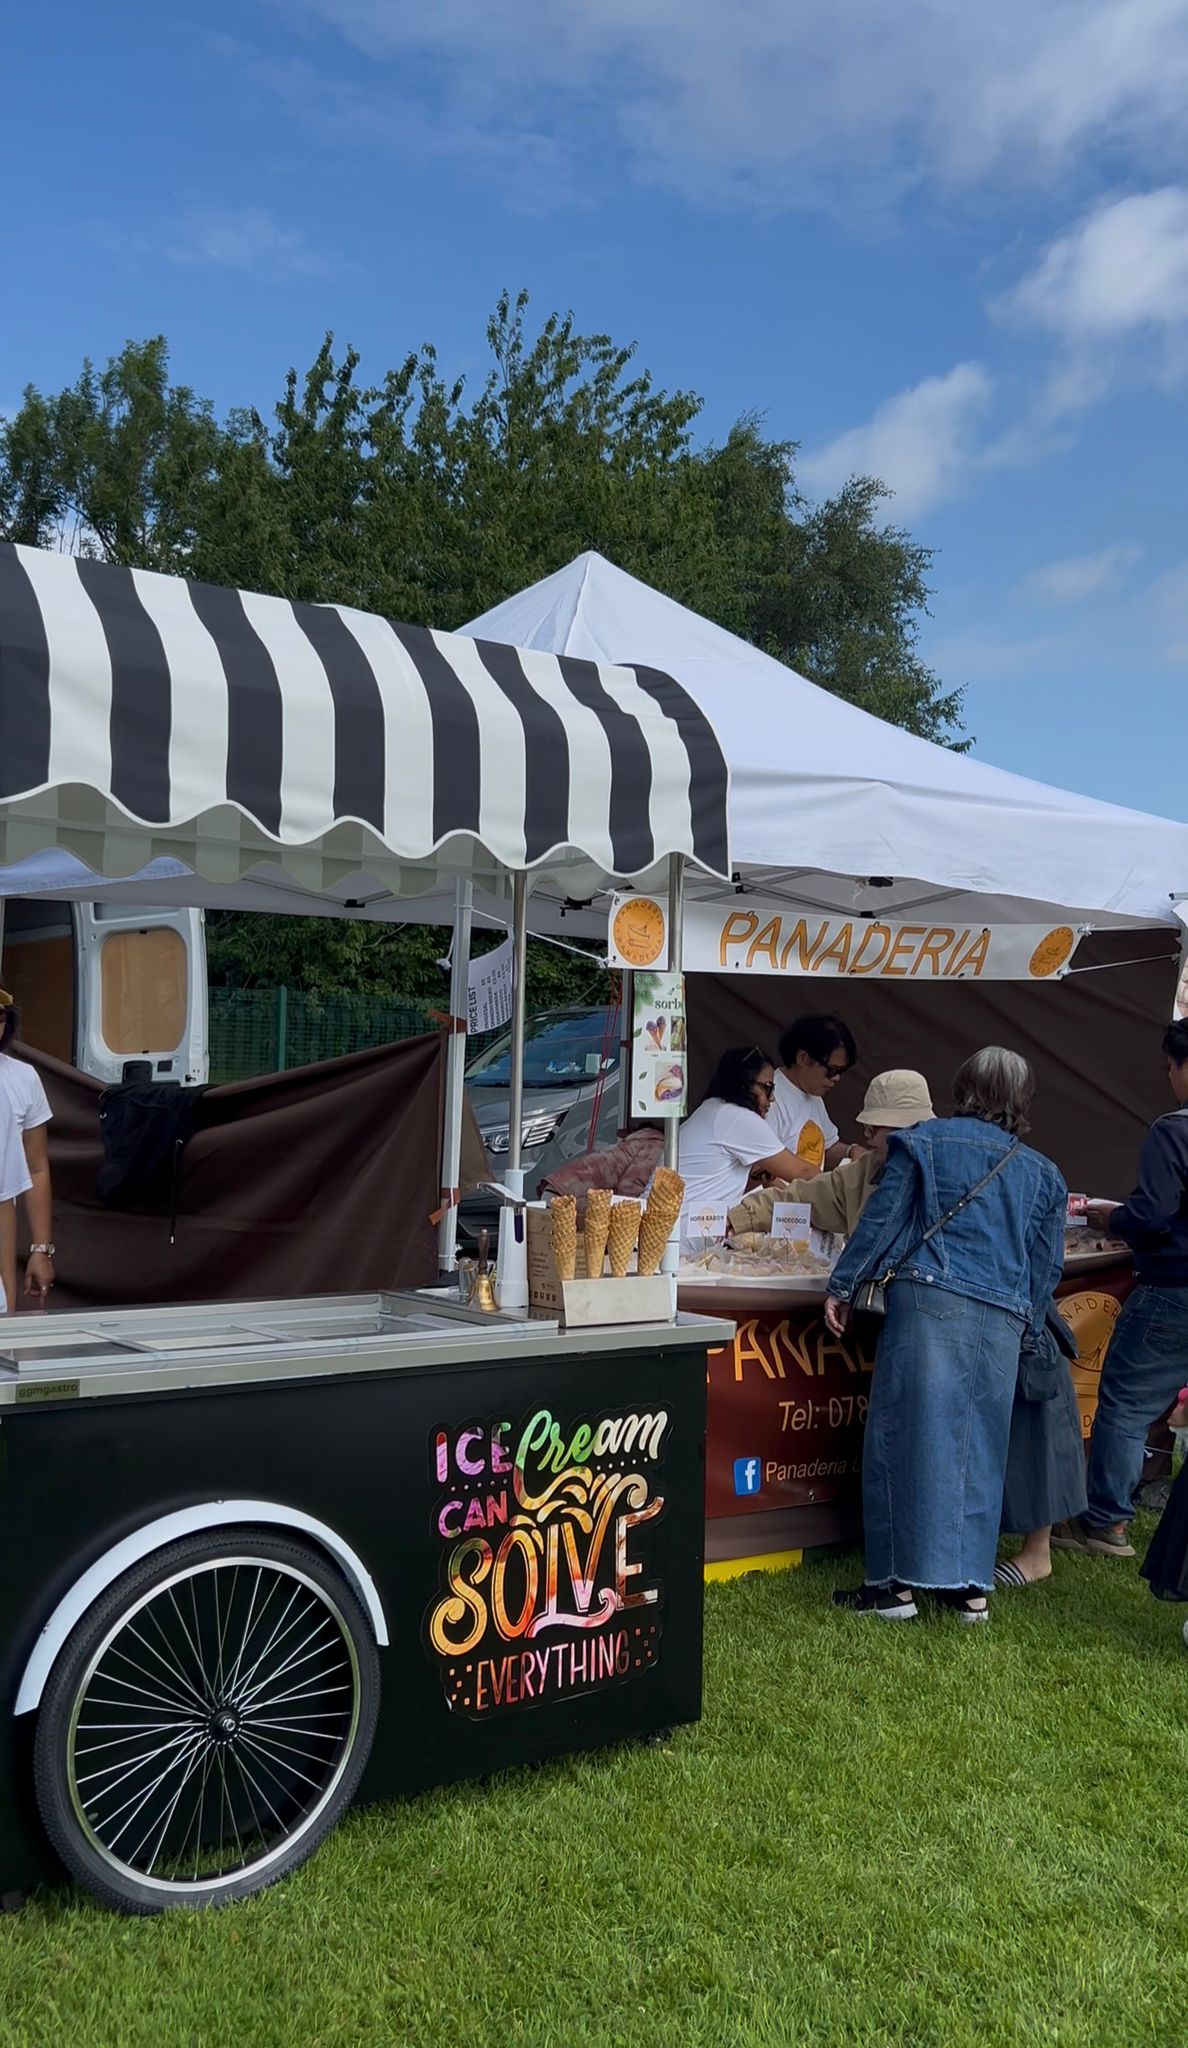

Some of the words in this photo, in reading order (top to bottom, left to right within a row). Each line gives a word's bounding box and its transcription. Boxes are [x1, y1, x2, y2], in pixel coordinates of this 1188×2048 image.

[720, 912, 991, 977] PANADERIA
[467, 986, 477, 1006] LIST
[654, 998, 682, 1010] sorb
[468, 1006, 478, 1034] PRICE
[18, 1383, 78, 1398] ggmgastro
[779, 1400, 819, 1432] Tel:
[828, 1395, 869, 1429] 078
[436, 1422, 513, 1483] ICE
[513, 1409, 668, 1511] Cream
[766, 1455, 848, 1483] Panaderia
[438, 1491, 508, 1539] CAN
[429, 1473, 665, 1657] SOLVE
[476, 1630, 629, 1711] EVERYTHING
